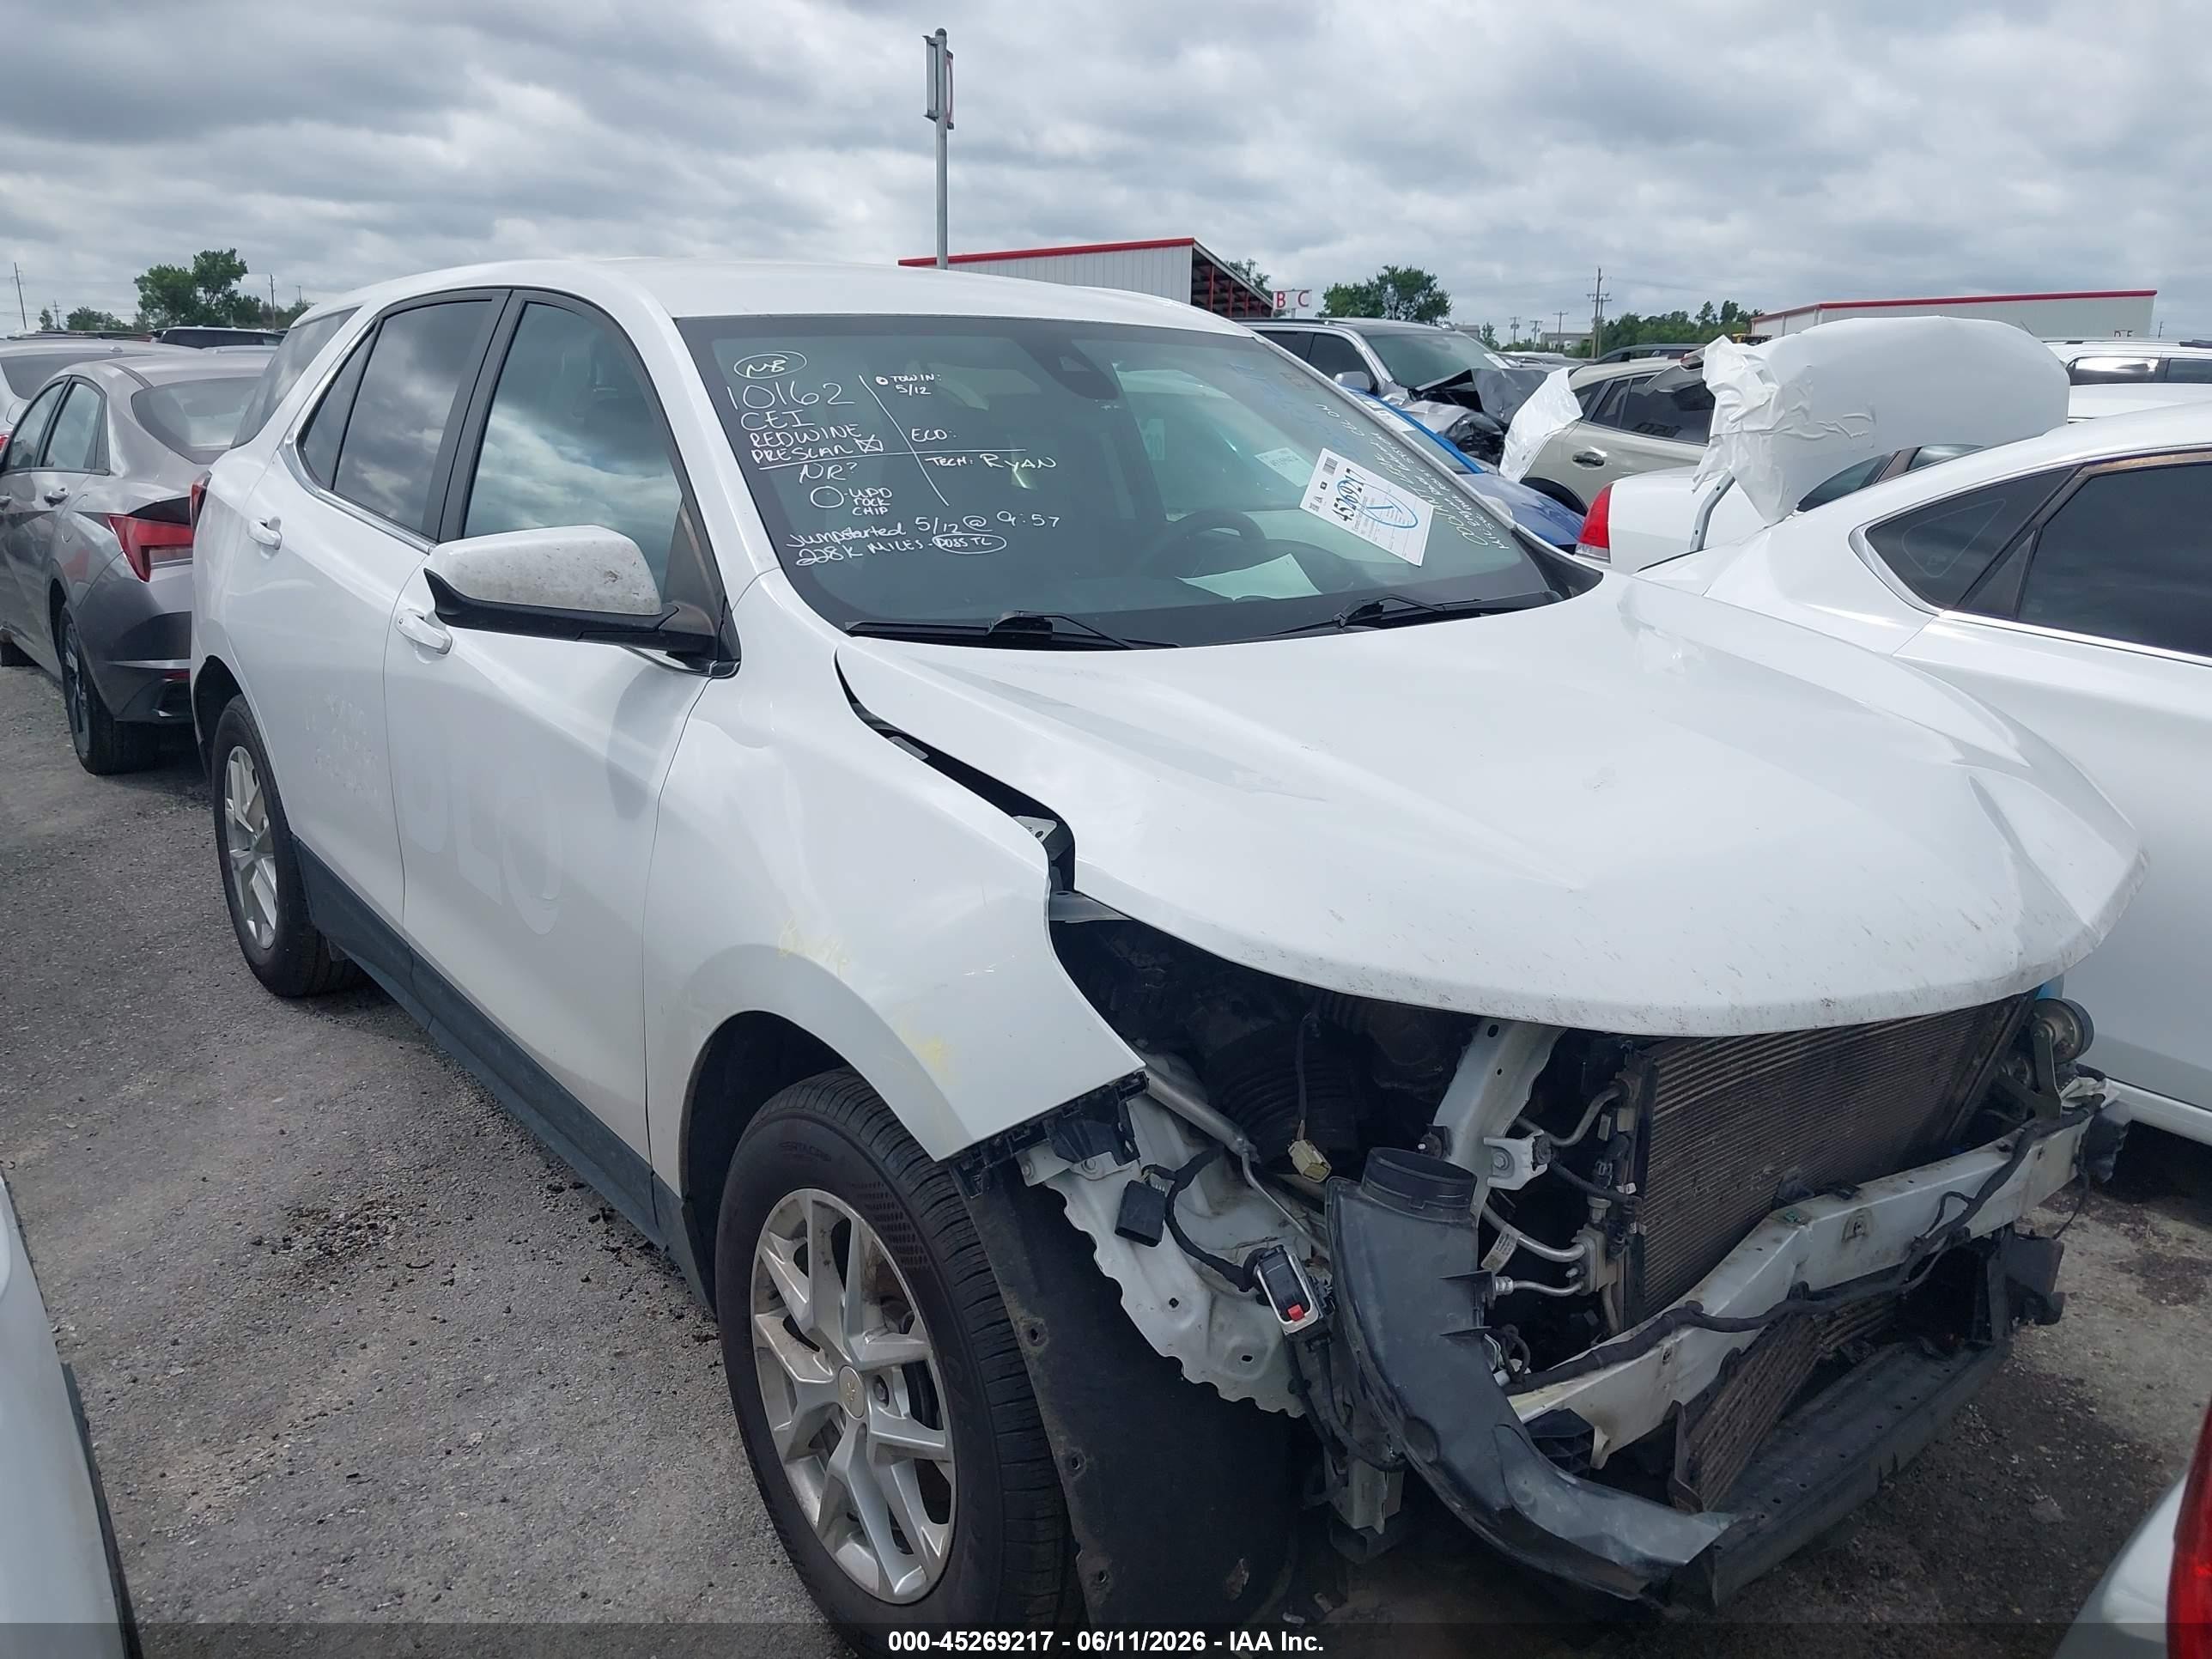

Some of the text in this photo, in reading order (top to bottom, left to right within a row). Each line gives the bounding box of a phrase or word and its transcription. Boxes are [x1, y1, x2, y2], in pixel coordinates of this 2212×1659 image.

[1277, 290, 1309, 308] B C
[726, 380, 855, 410] 10162
[895, 383, 933, 396] 5/12
[750, 423, 861, 447] REDWINE
[924, 456, 974, 467] TECH:
[1332, 467, 1366, 522] 45269217
[852, 507, 889, 516] CHIP
[915, 516, 963, 534] 5/12
[963, 515, 994, 532] @
[996, 510, 1060, 528] 9:57
